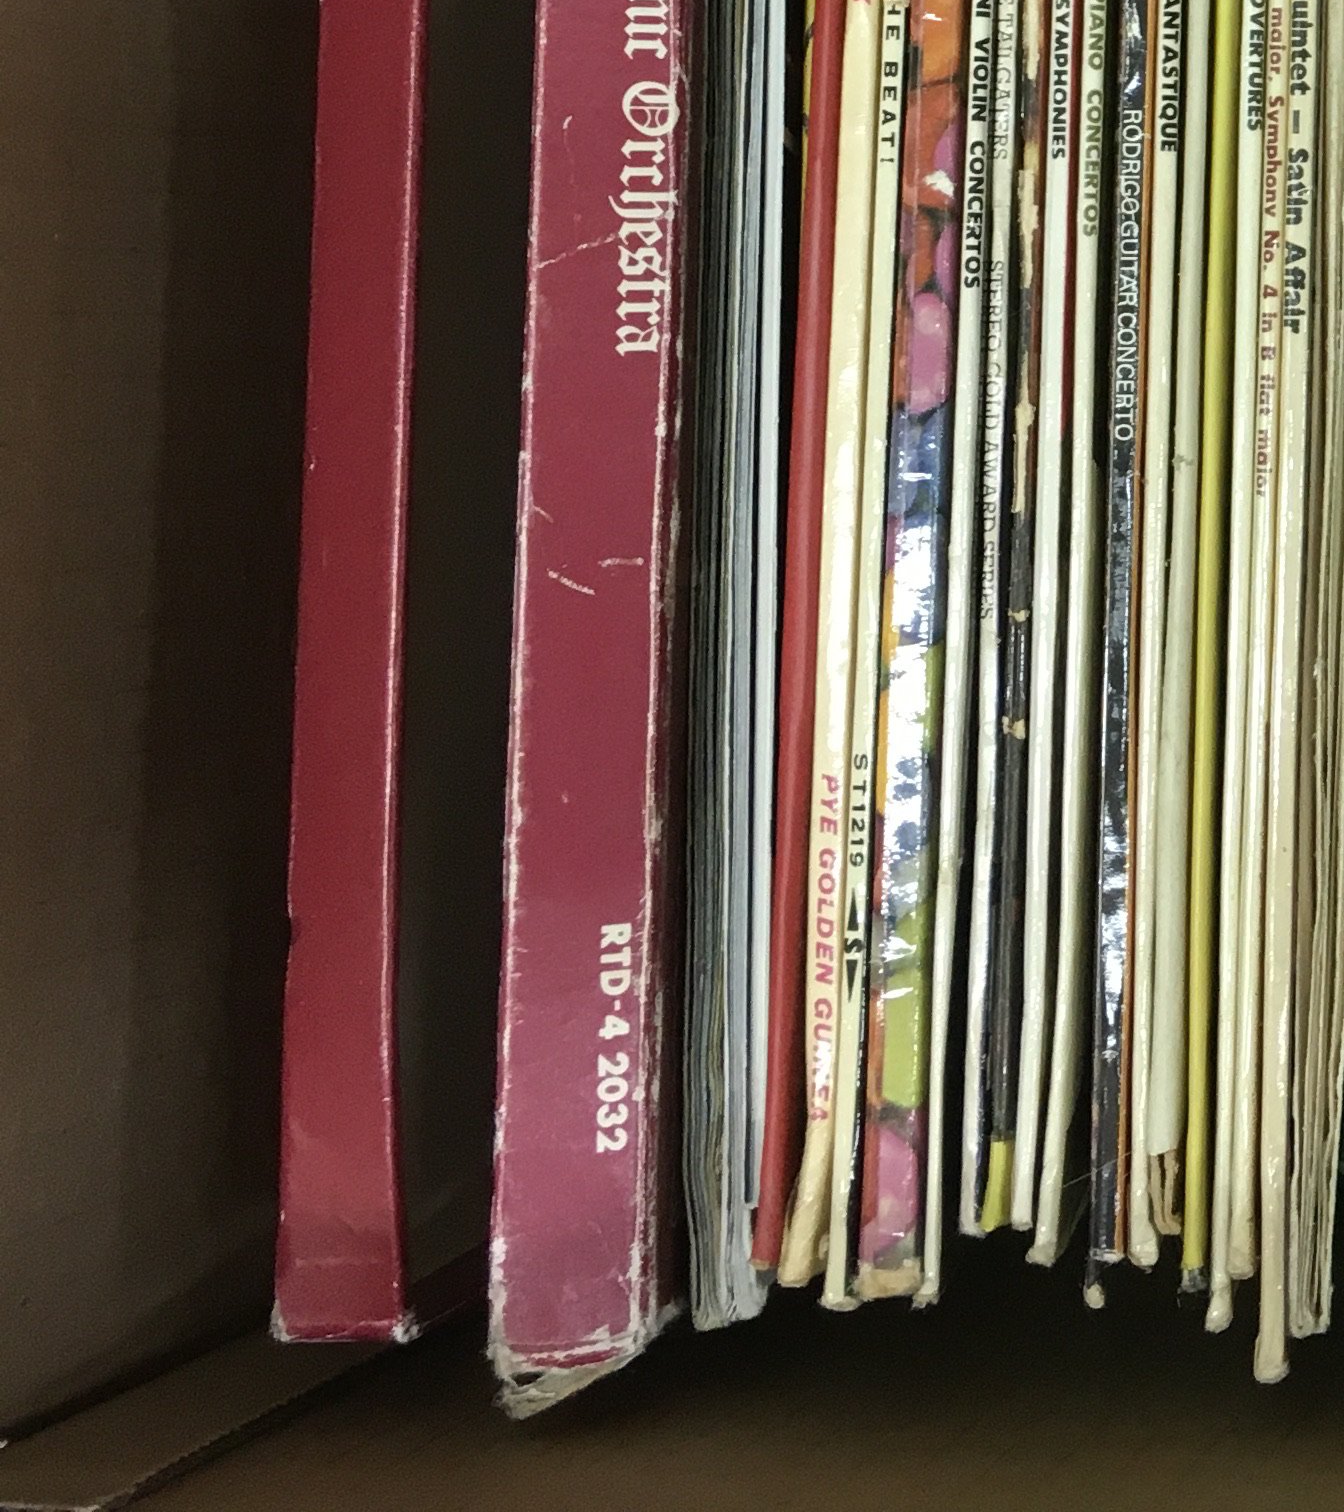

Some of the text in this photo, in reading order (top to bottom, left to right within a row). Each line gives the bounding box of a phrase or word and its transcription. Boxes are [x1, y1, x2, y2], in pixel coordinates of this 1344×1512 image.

[609, 81, 679, 356] Orchestra
[596, 924, 631, 1153] RTD-4 2032
